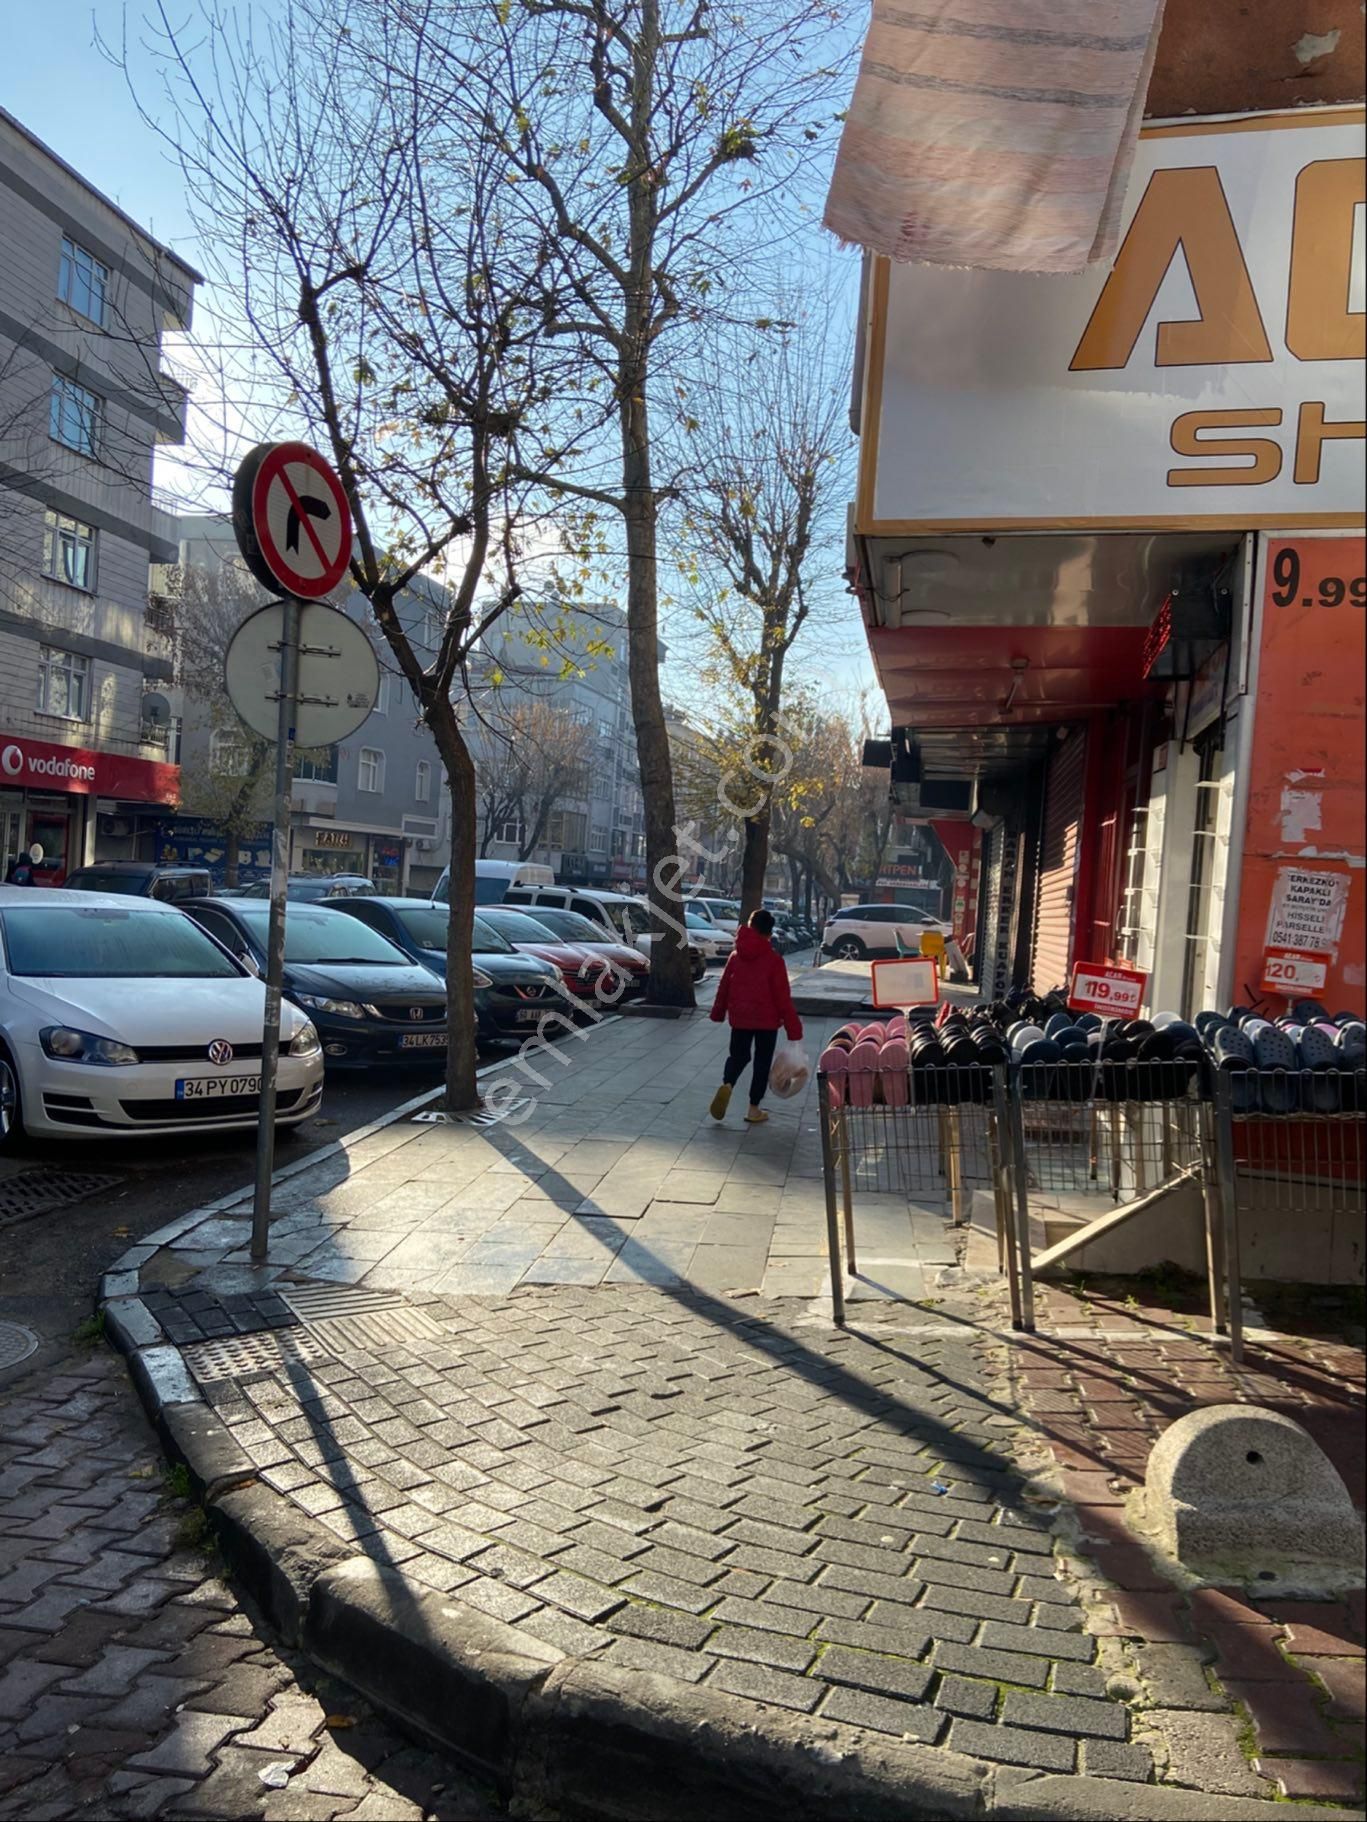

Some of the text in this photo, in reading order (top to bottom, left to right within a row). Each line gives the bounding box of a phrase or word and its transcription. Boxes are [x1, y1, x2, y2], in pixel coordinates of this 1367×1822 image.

[28, 756, 95, 780] vodafone
[185, 1082, 203, 1097] 34
[206, 1080, 228, 1095] PY
